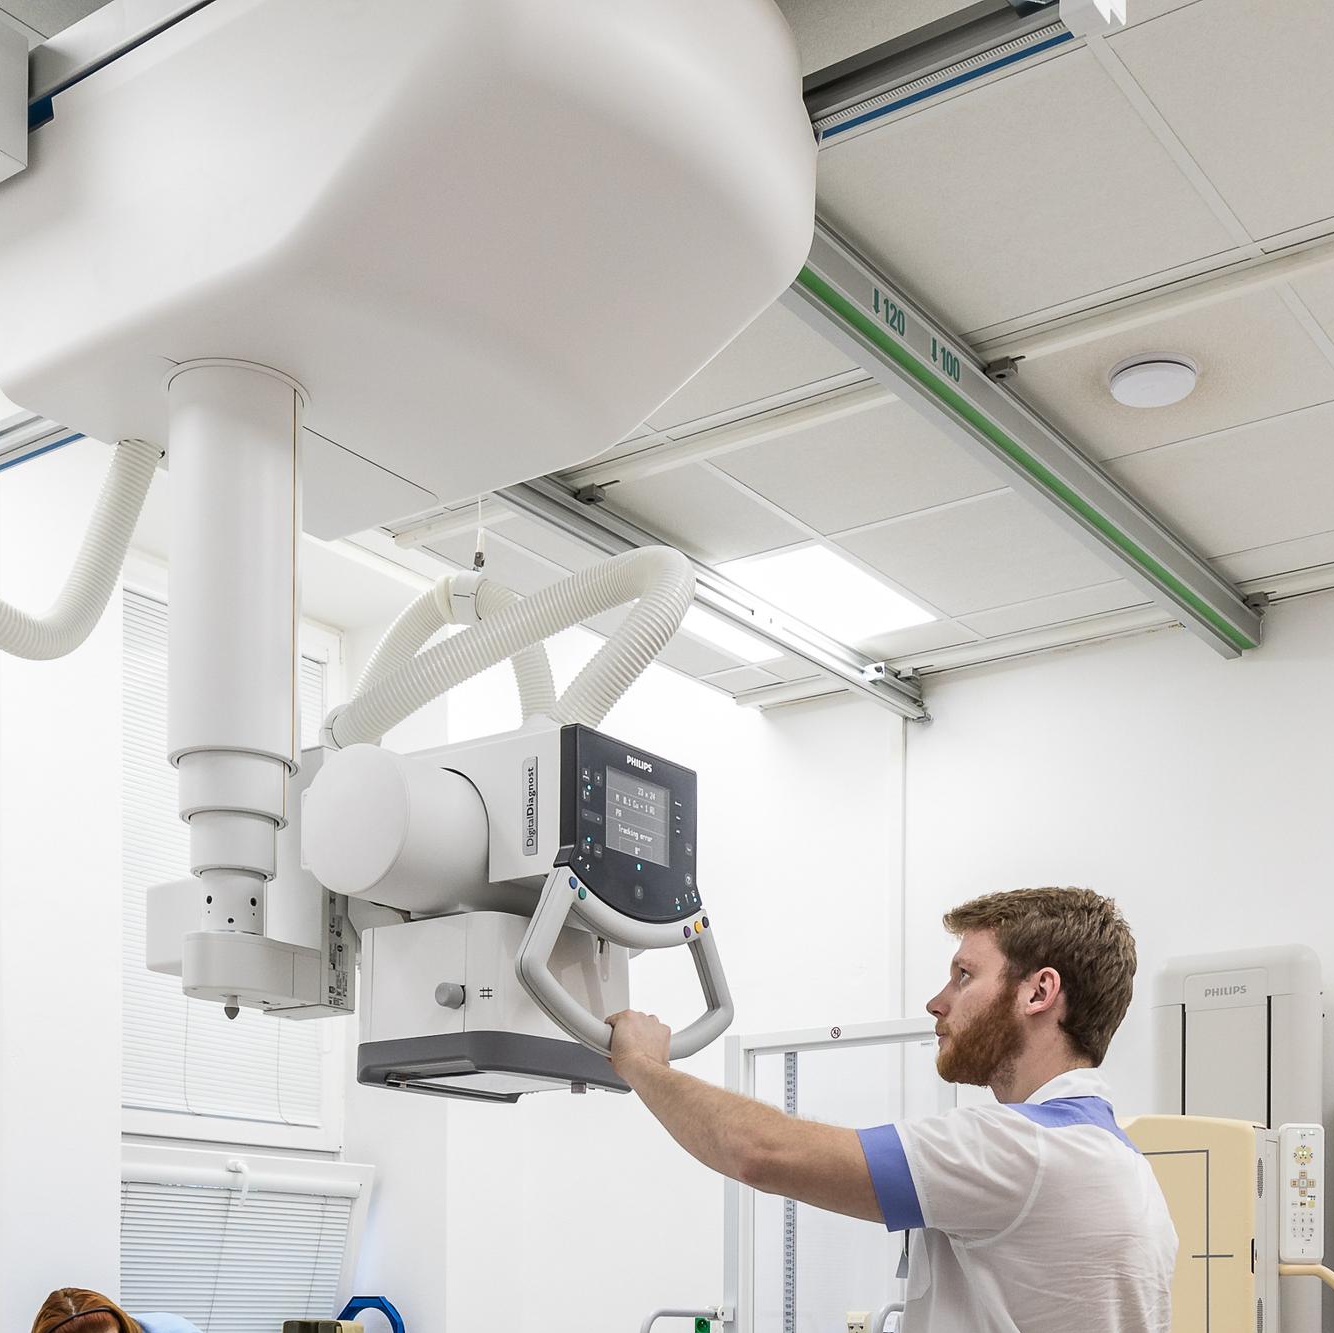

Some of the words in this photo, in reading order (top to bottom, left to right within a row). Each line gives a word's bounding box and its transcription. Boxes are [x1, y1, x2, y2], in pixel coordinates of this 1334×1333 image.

[883, 298, 905, 337] 120
[940, 346, 960, 383] 100
[626, 755, 653, 773] PHILIPS
[526, 766, 536, 847] DigitalDiagnost
[618, 824, 639, 841] Tracking
[639, 834, 653, 842] error
[1204, 985, 1247, 998] PHILIPS
